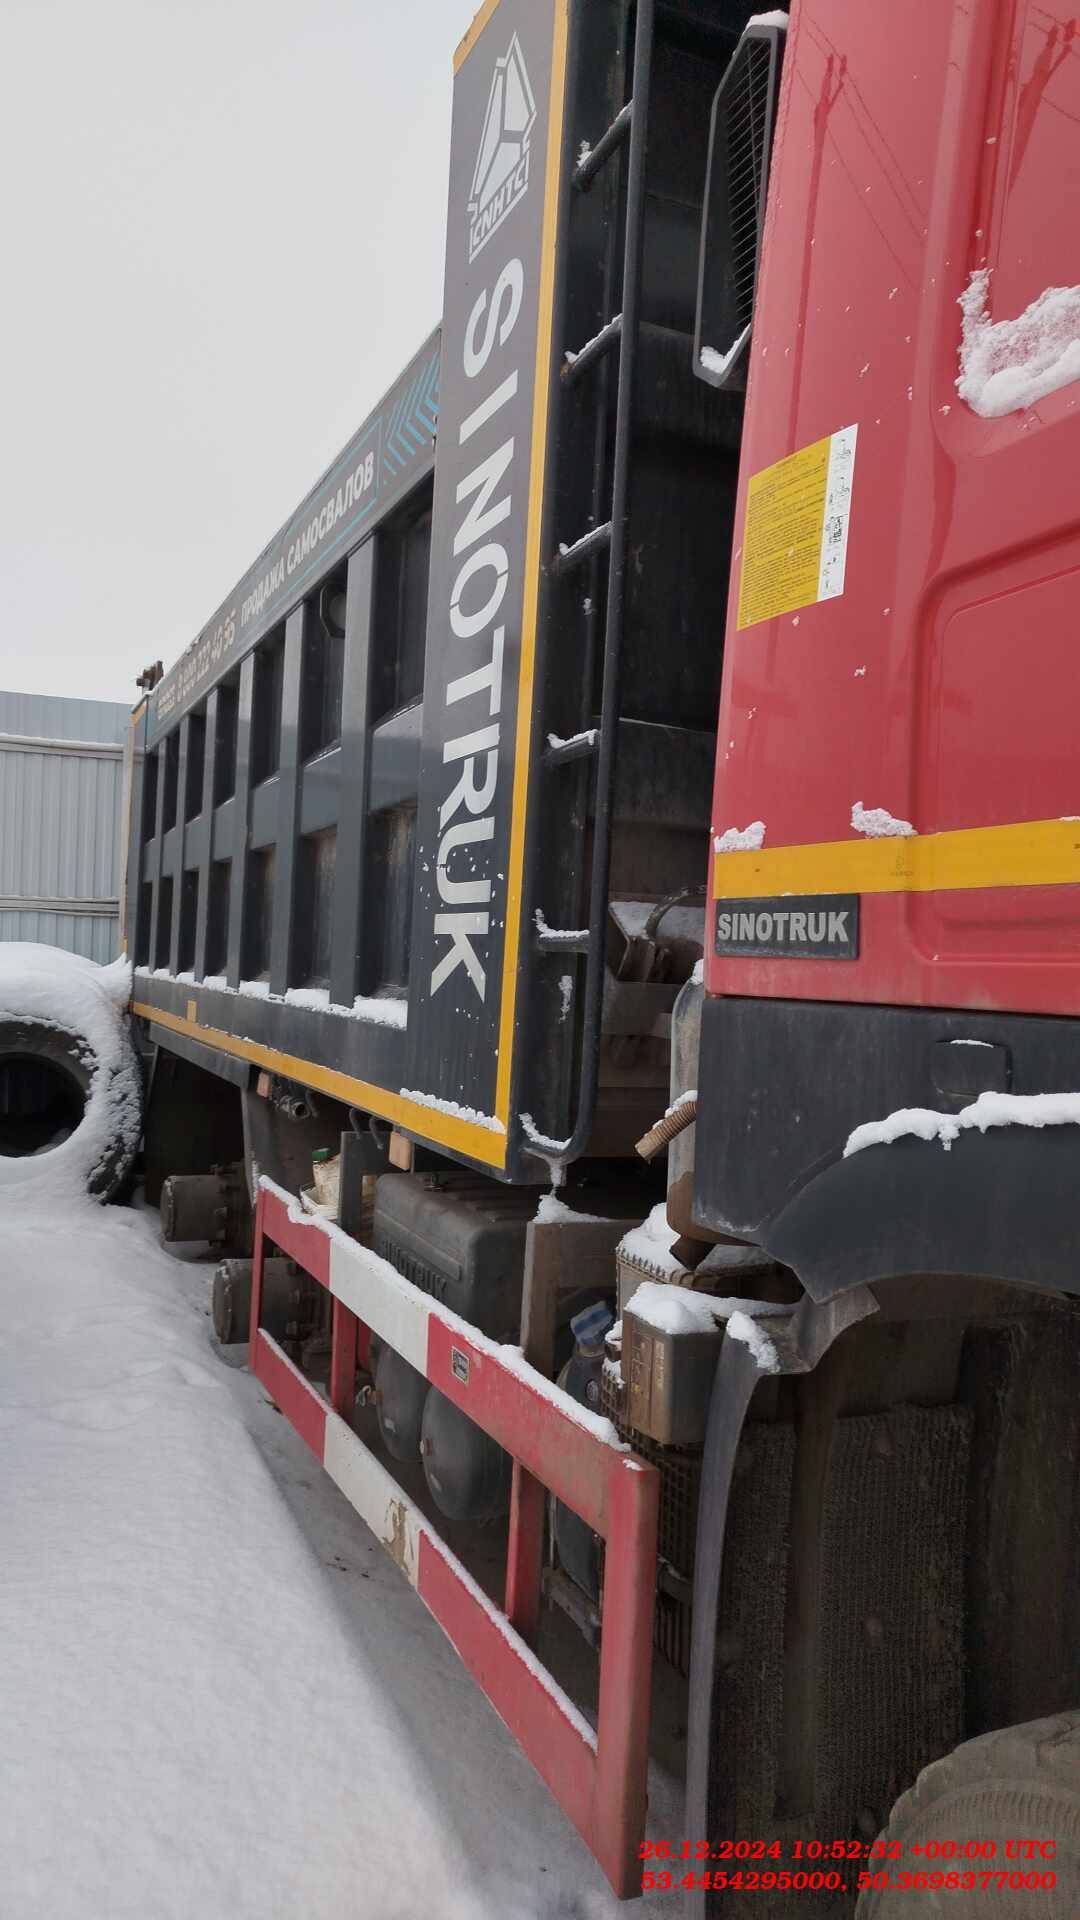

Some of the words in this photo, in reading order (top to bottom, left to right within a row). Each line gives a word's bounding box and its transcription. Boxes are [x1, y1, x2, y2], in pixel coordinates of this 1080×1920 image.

[240, 556, 285, 627] ПРОДАЖА
[286, 451, 375, 575] САМОСВАЛОВ
[431, 257, 526, 1002] SINOTRUK
[717, 911, 849, 942] SINOTRUK
